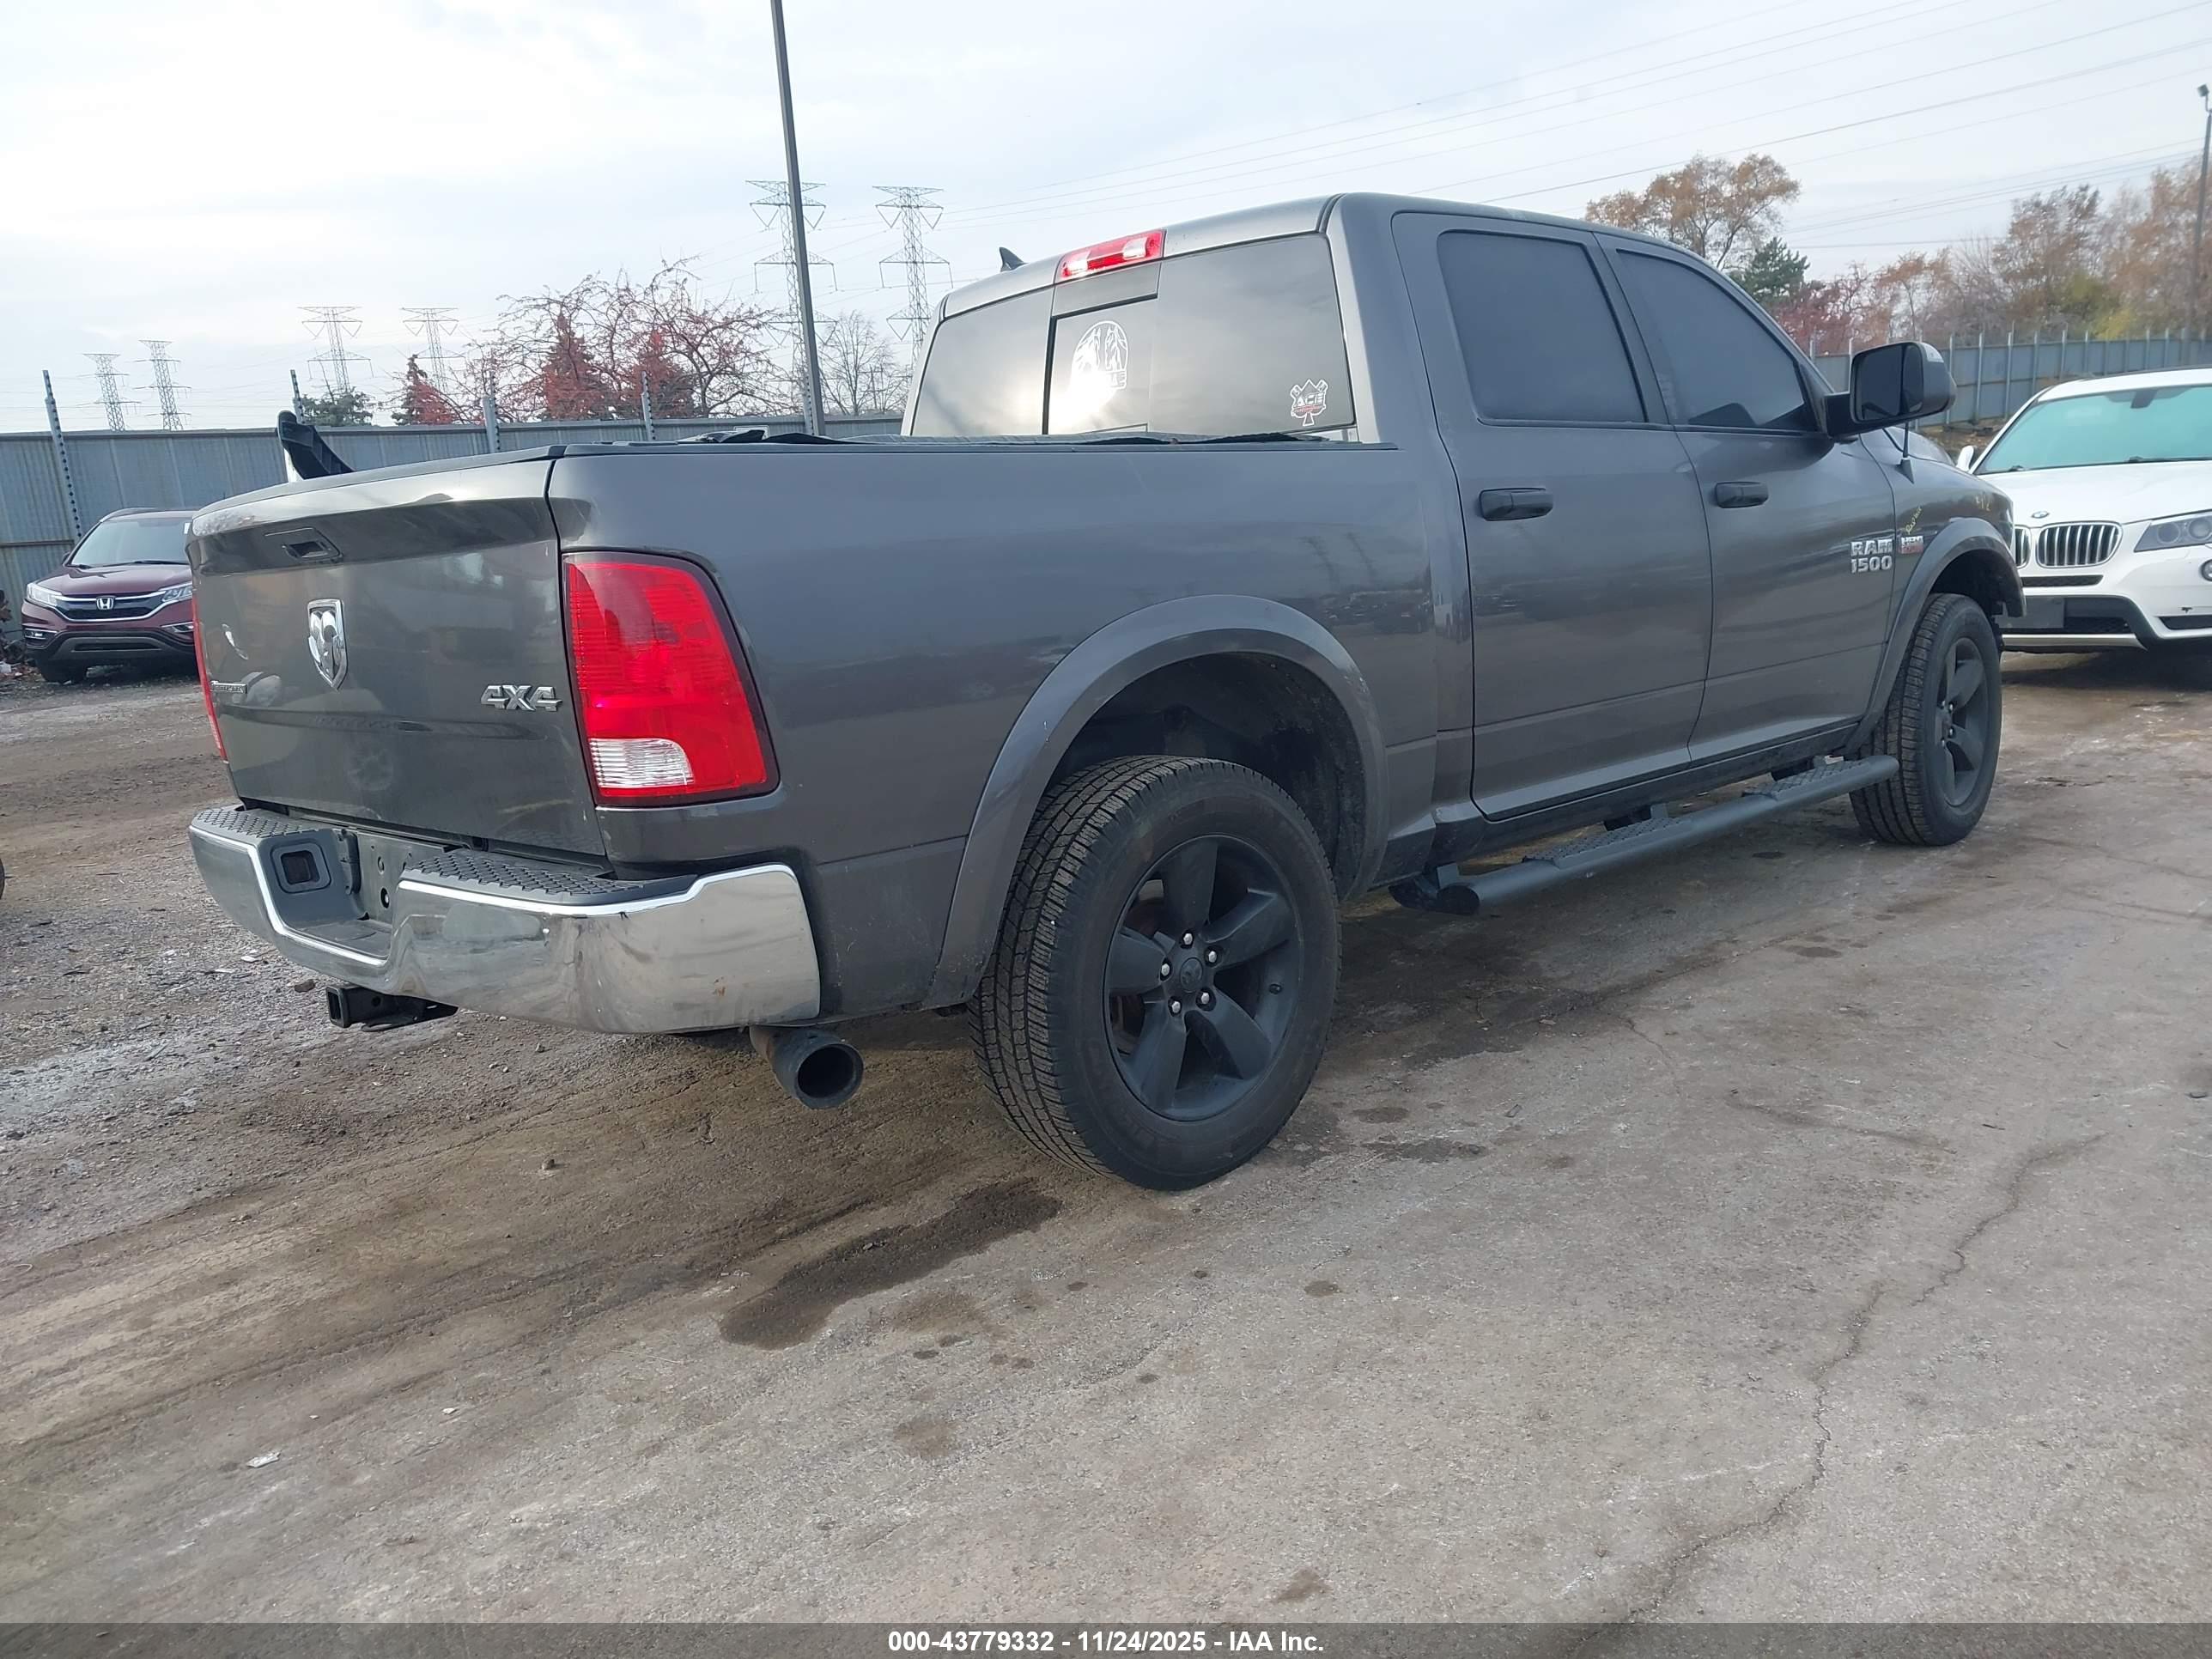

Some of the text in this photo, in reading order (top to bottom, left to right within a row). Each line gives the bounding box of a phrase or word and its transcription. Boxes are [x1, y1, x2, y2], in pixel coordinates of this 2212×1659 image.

[1297, 392, 1323, 407] ACE
[1850, 539, 1893, 556] RAM
[1850, 555, 1893, 574] 1500
